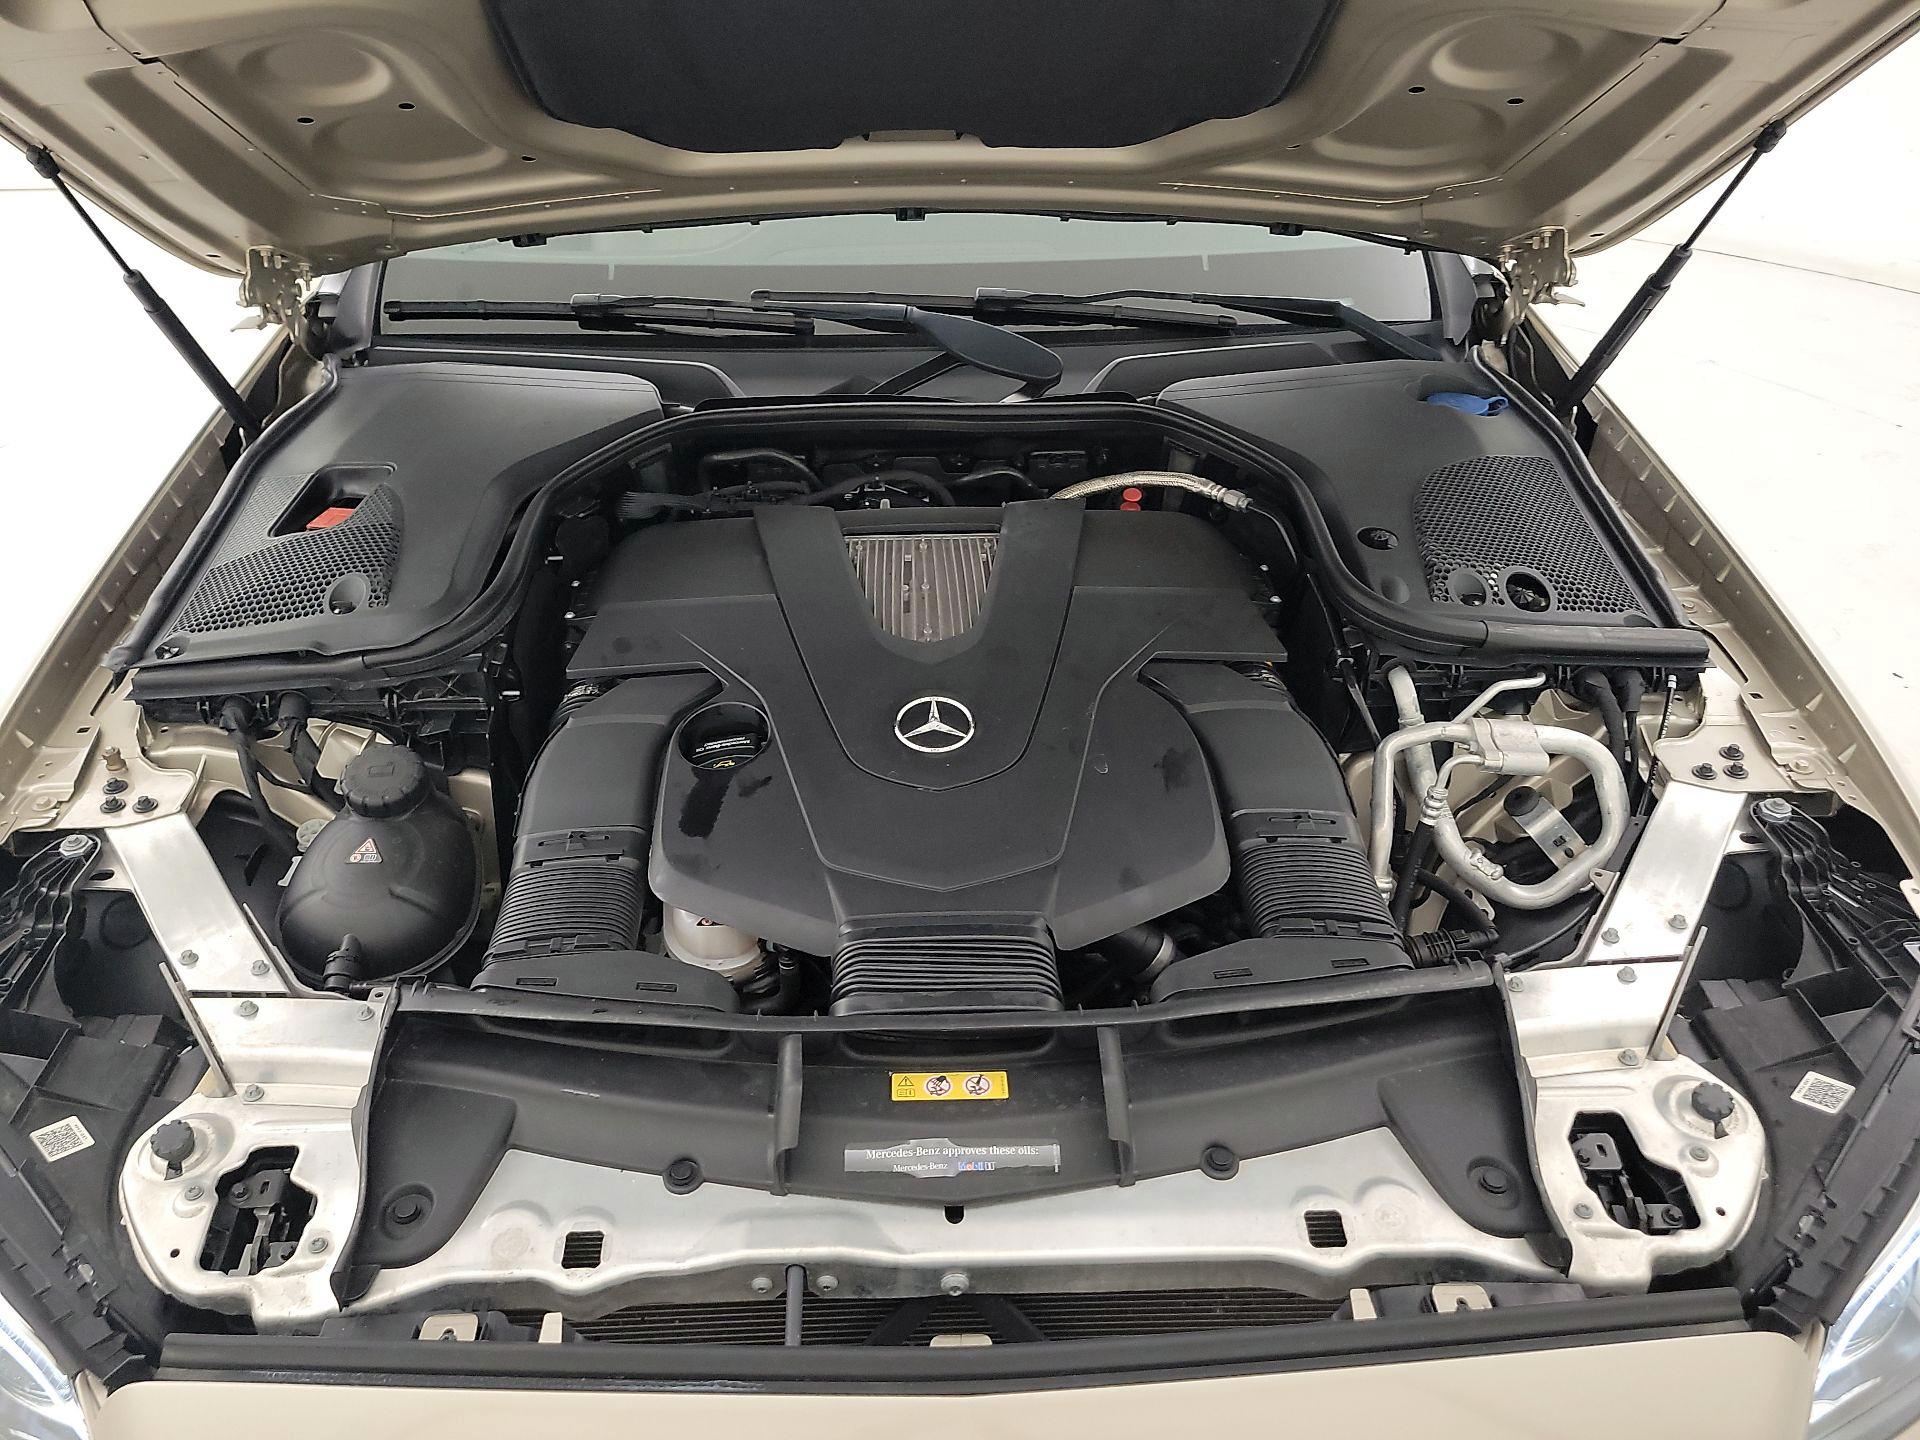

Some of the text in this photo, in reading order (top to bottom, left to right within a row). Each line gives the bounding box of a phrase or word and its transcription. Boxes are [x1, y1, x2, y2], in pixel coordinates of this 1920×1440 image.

[866, 1145, 1039, 1159] Mercedes-Benz approves these oils:
[892, 1161, 948, 1173] Mercedes-Benz
